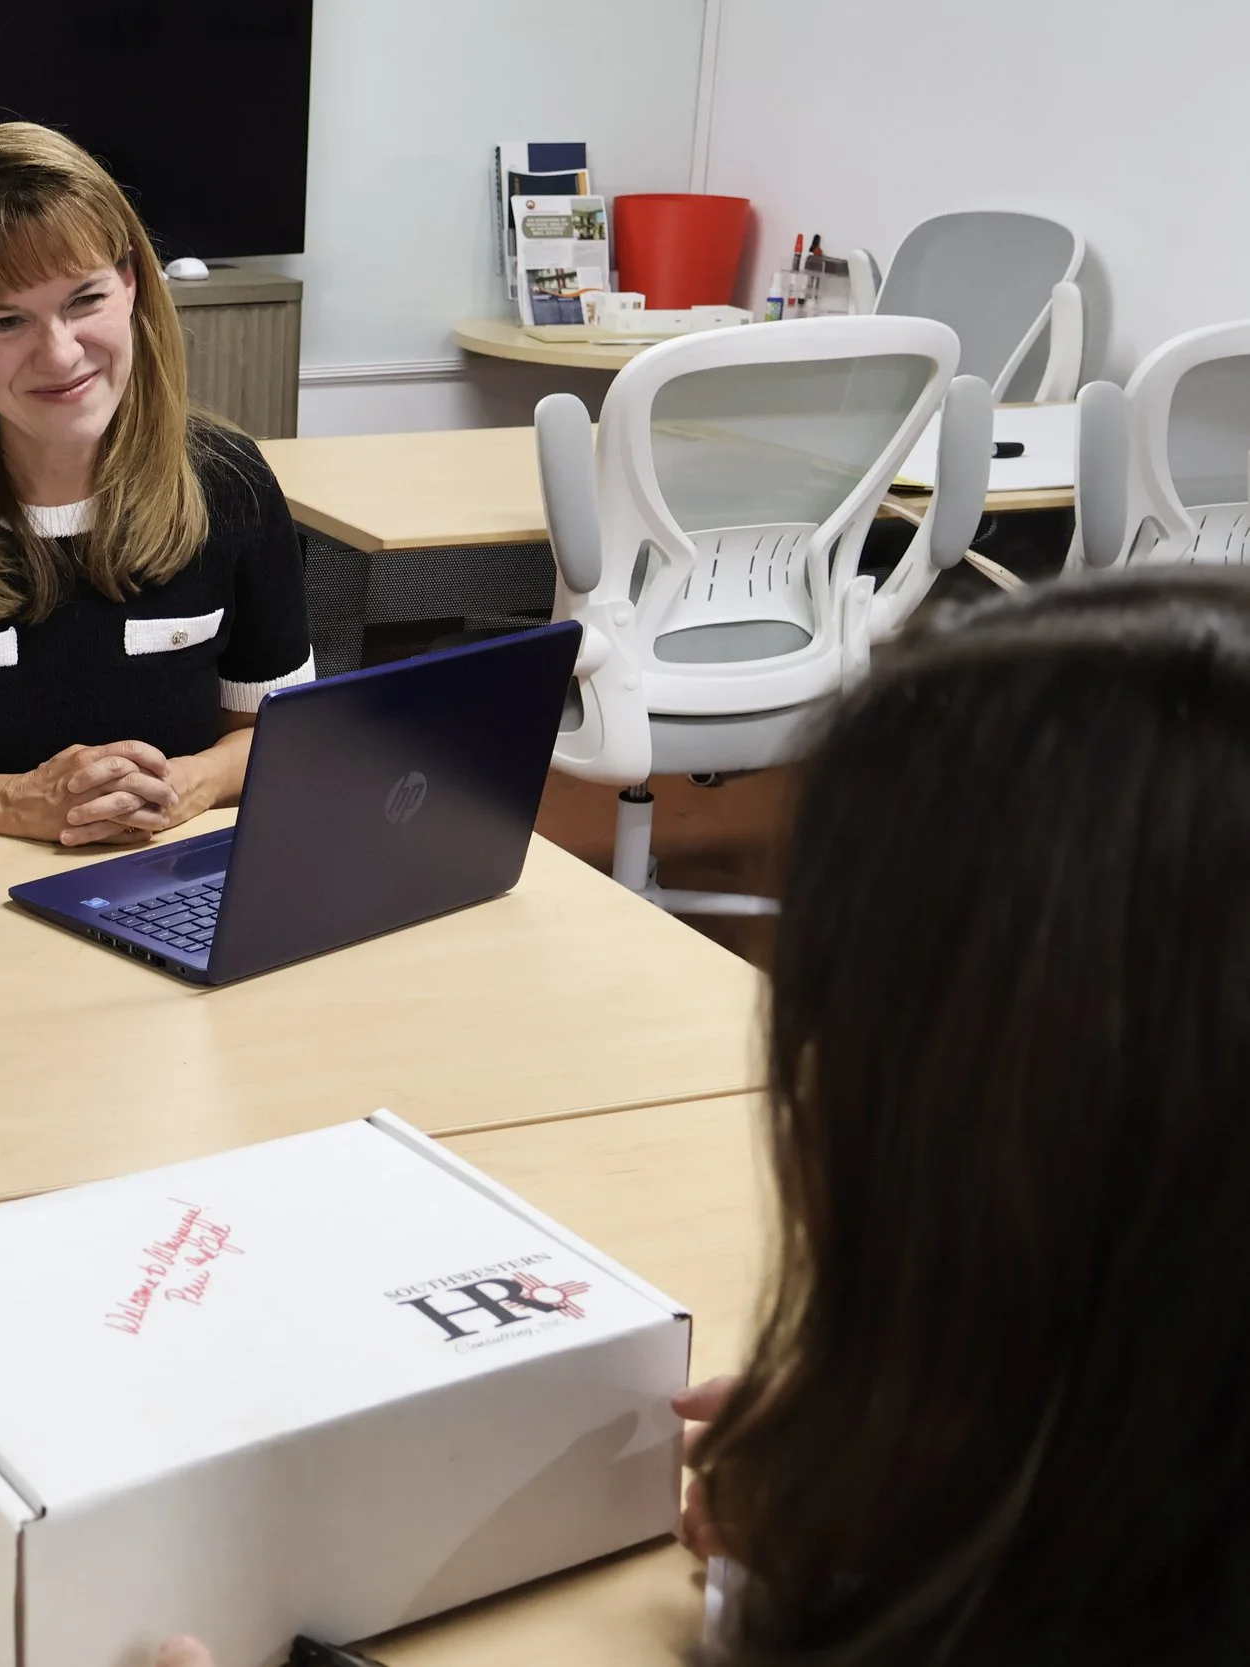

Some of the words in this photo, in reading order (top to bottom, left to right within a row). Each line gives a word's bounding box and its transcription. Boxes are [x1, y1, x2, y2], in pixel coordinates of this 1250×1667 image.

[388, 772, 426, 823] hp
[103, 1277, 161, 1335] Welcome
[136, 1263, 167, 1276] to
[383, 1251, 552, 1302] SOUTHWESTERN
[396, 1277, 569, 1342] HR
